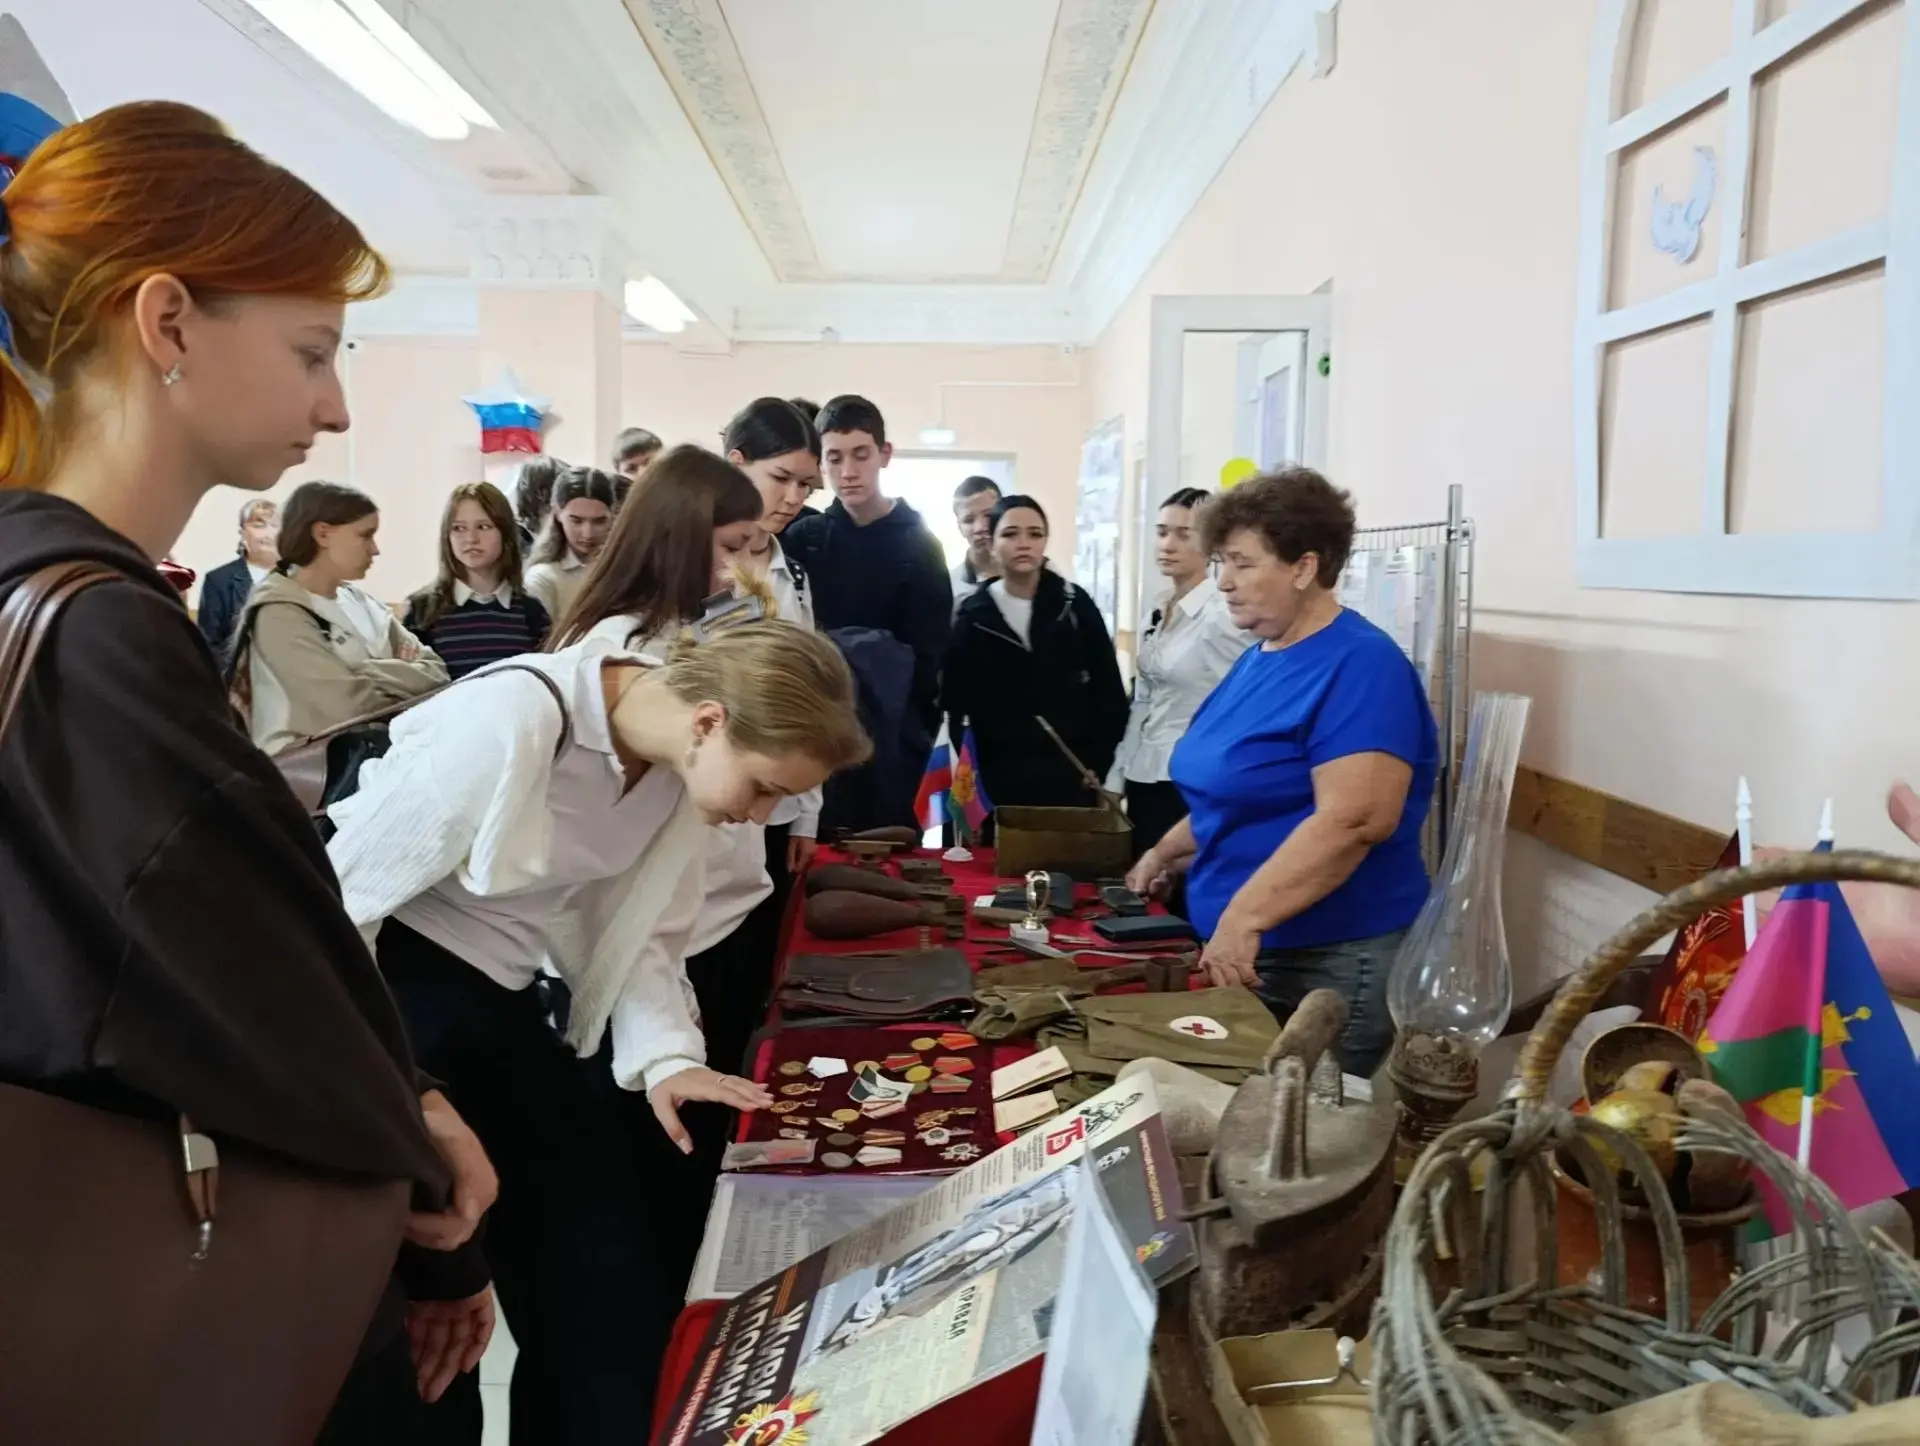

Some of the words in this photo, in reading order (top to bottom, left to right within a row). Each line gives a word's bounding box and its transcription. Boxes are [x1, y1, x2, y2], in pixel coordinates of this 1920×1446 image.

[744, 1285, 777, 1314] И
[945, 1284, 977, 1341] ПРАВДА
[694, 1308, 768, 1437] ПОМНИ!
[738, 1301, 808, 1409] ЖИВИ
